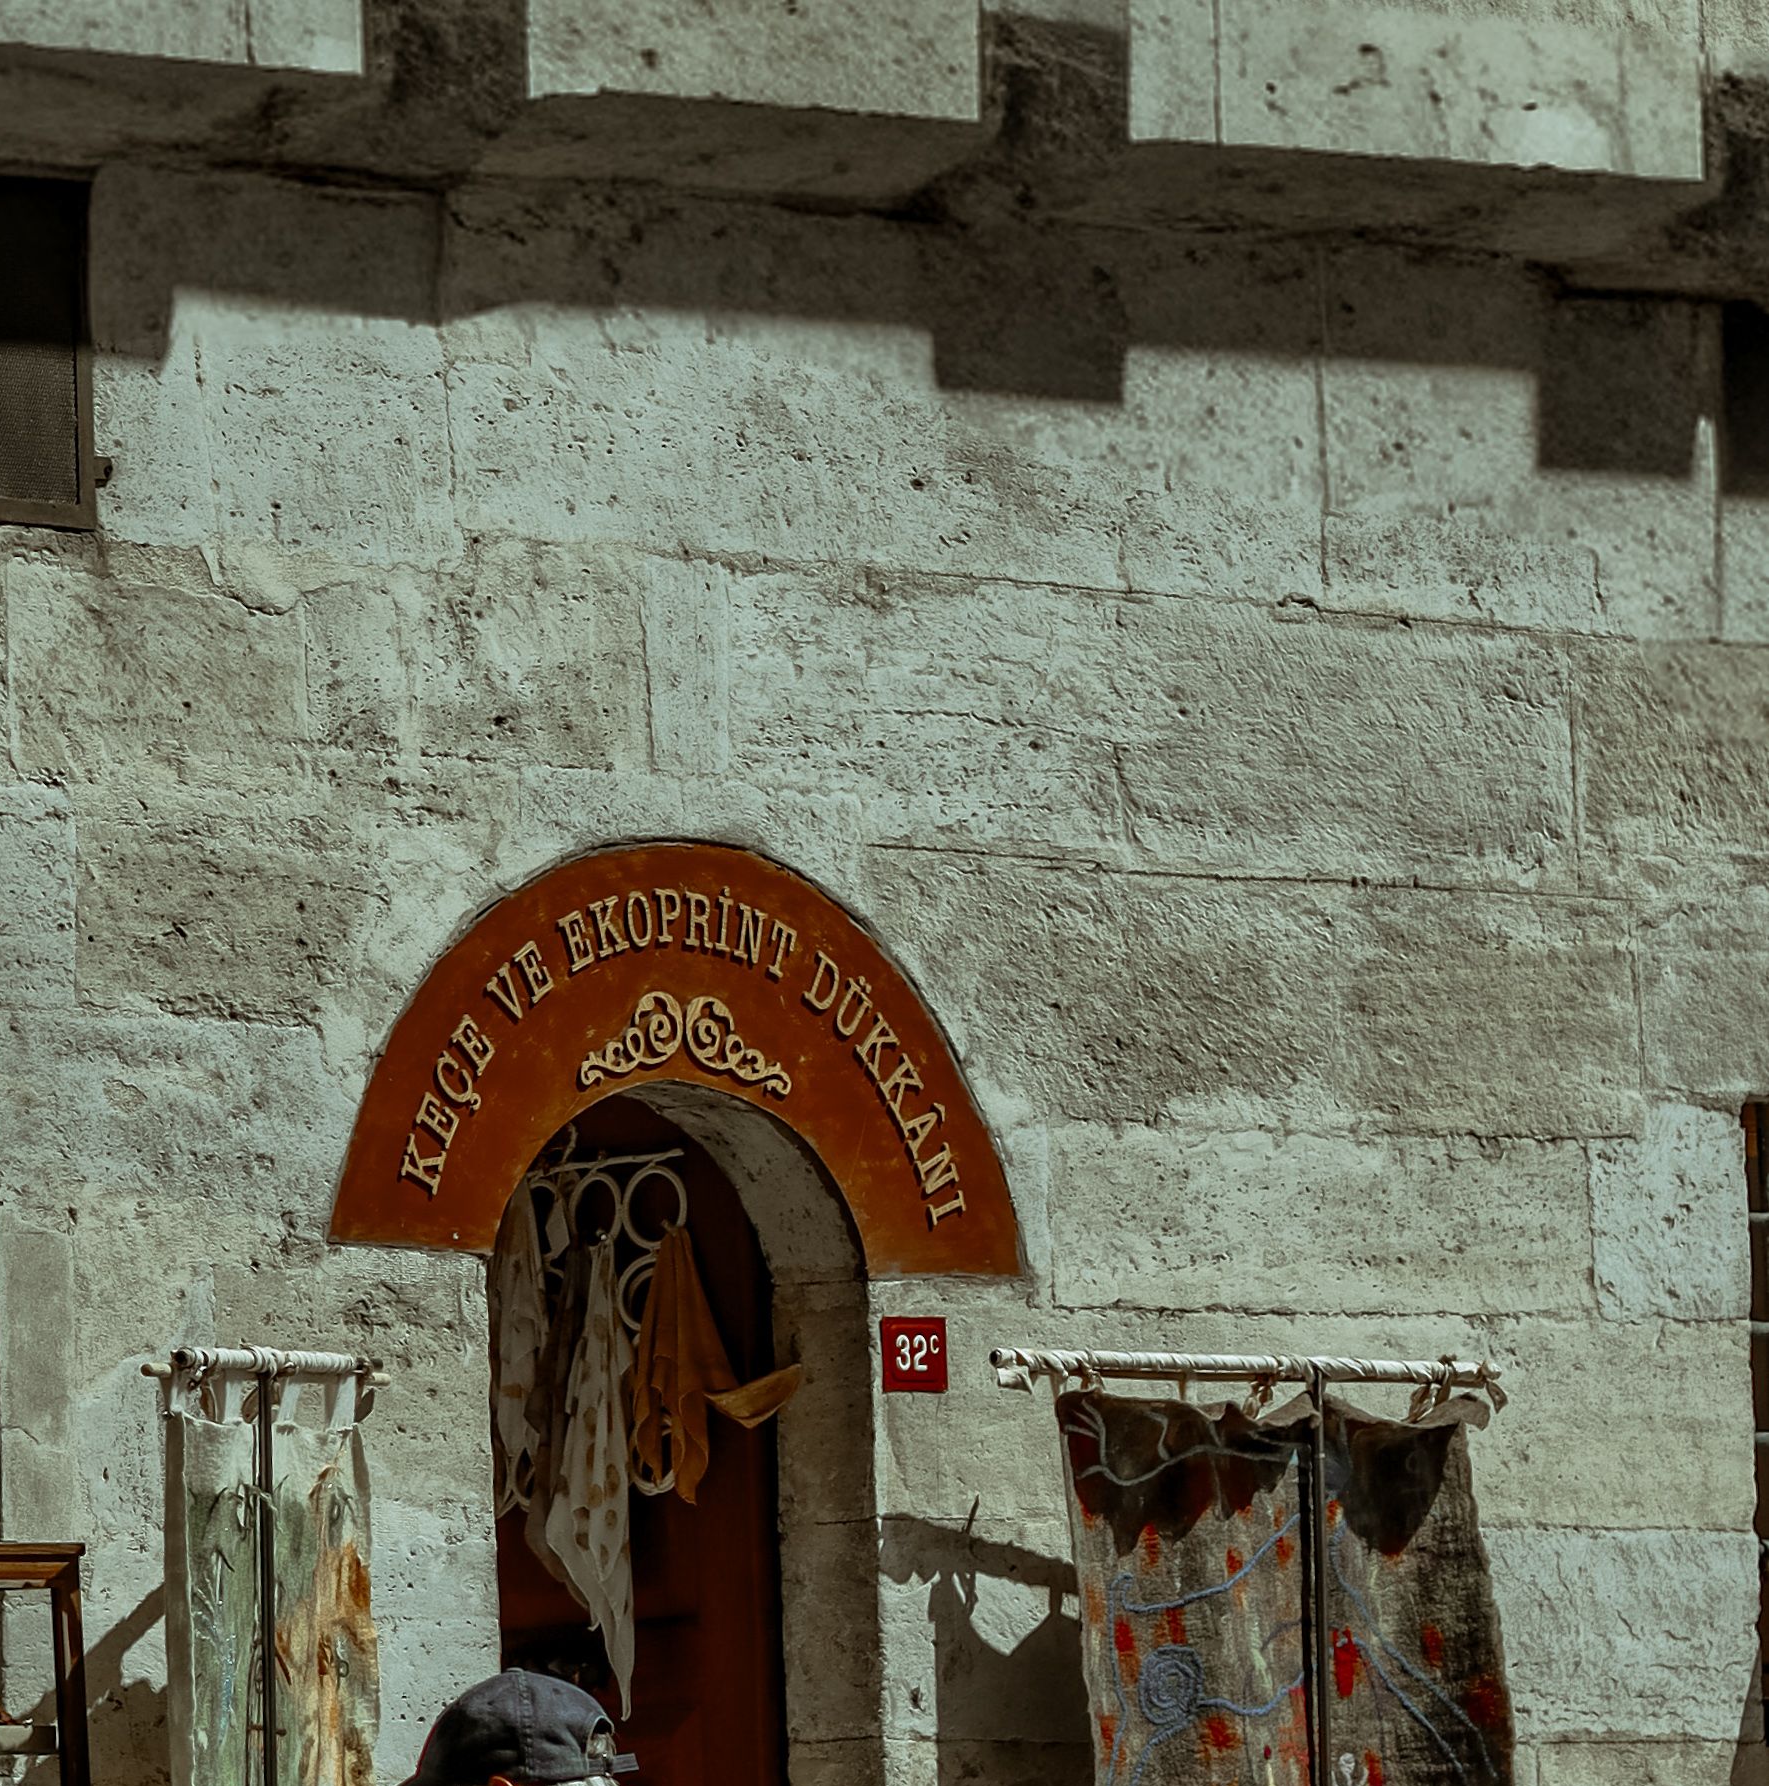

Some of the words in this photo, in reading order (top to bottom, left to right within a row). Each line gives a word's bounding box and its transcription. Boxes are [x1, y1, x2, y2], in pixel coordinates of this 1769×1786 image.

[400, 1013, 496, 1196] KEÇE
[486, 940, 555, 1021] VE
[558, 886, 798, 979] EKOPRİNT
[802, 950, 968, 1228] DÜKKÂNI
[895, 1334, 940, 1372] 32C
